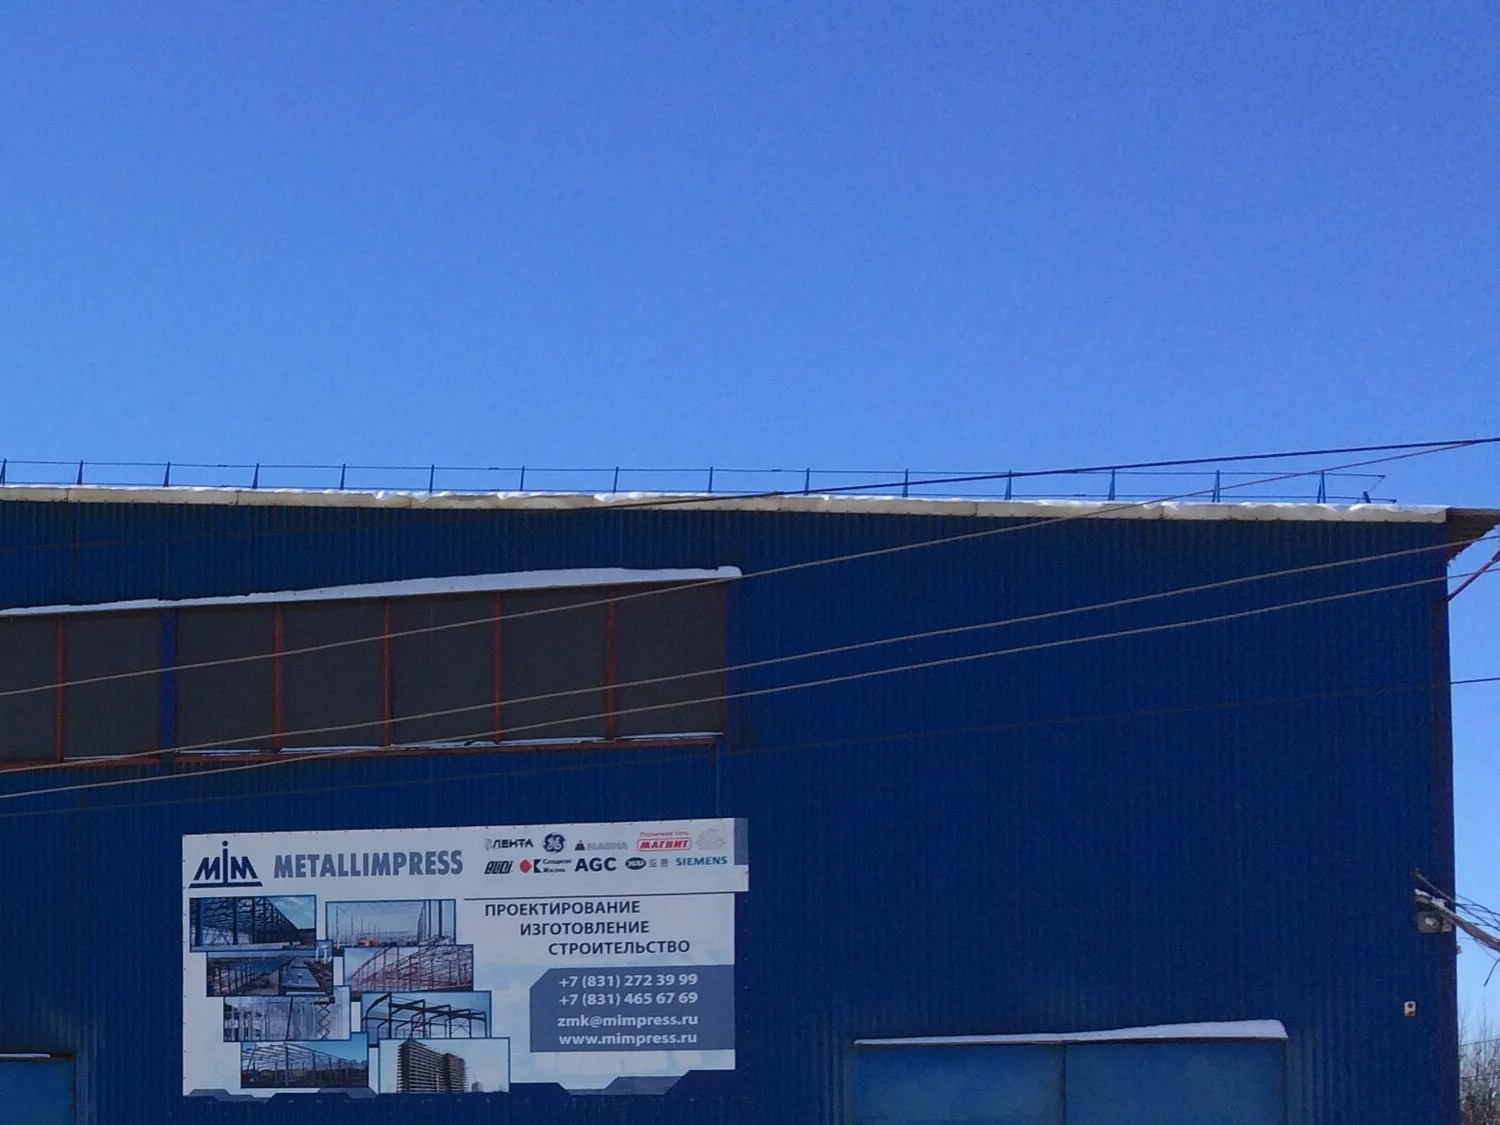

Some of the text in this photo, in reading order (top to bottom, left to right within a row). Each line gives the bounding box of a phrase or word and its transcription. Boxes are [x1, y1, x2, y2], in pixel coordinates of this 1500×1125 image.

[273, 850, 464, 879] METALLIMPRESS
[574, 857, 617, 872] AGC
[675, 856, 728, 867] SIEMENS
[484, 900, 640, 917] ПРОЕКТИРОВАНИЕ
[520, 920, 650, 936] ИЗГОТОВЛЕНИЕ
[548, 940, 690, 956] СТРОИТЕЛЬСТВО
[559, 973, 698, 989] +7 (831) 272 39 99
[559, 992, 698, 1007] +7 (831) 465 67 69
[557, 1014, 699, 1029] zmk@mimpress.ru
[559, 1033, 698, 1046] www.mimpress.ru
